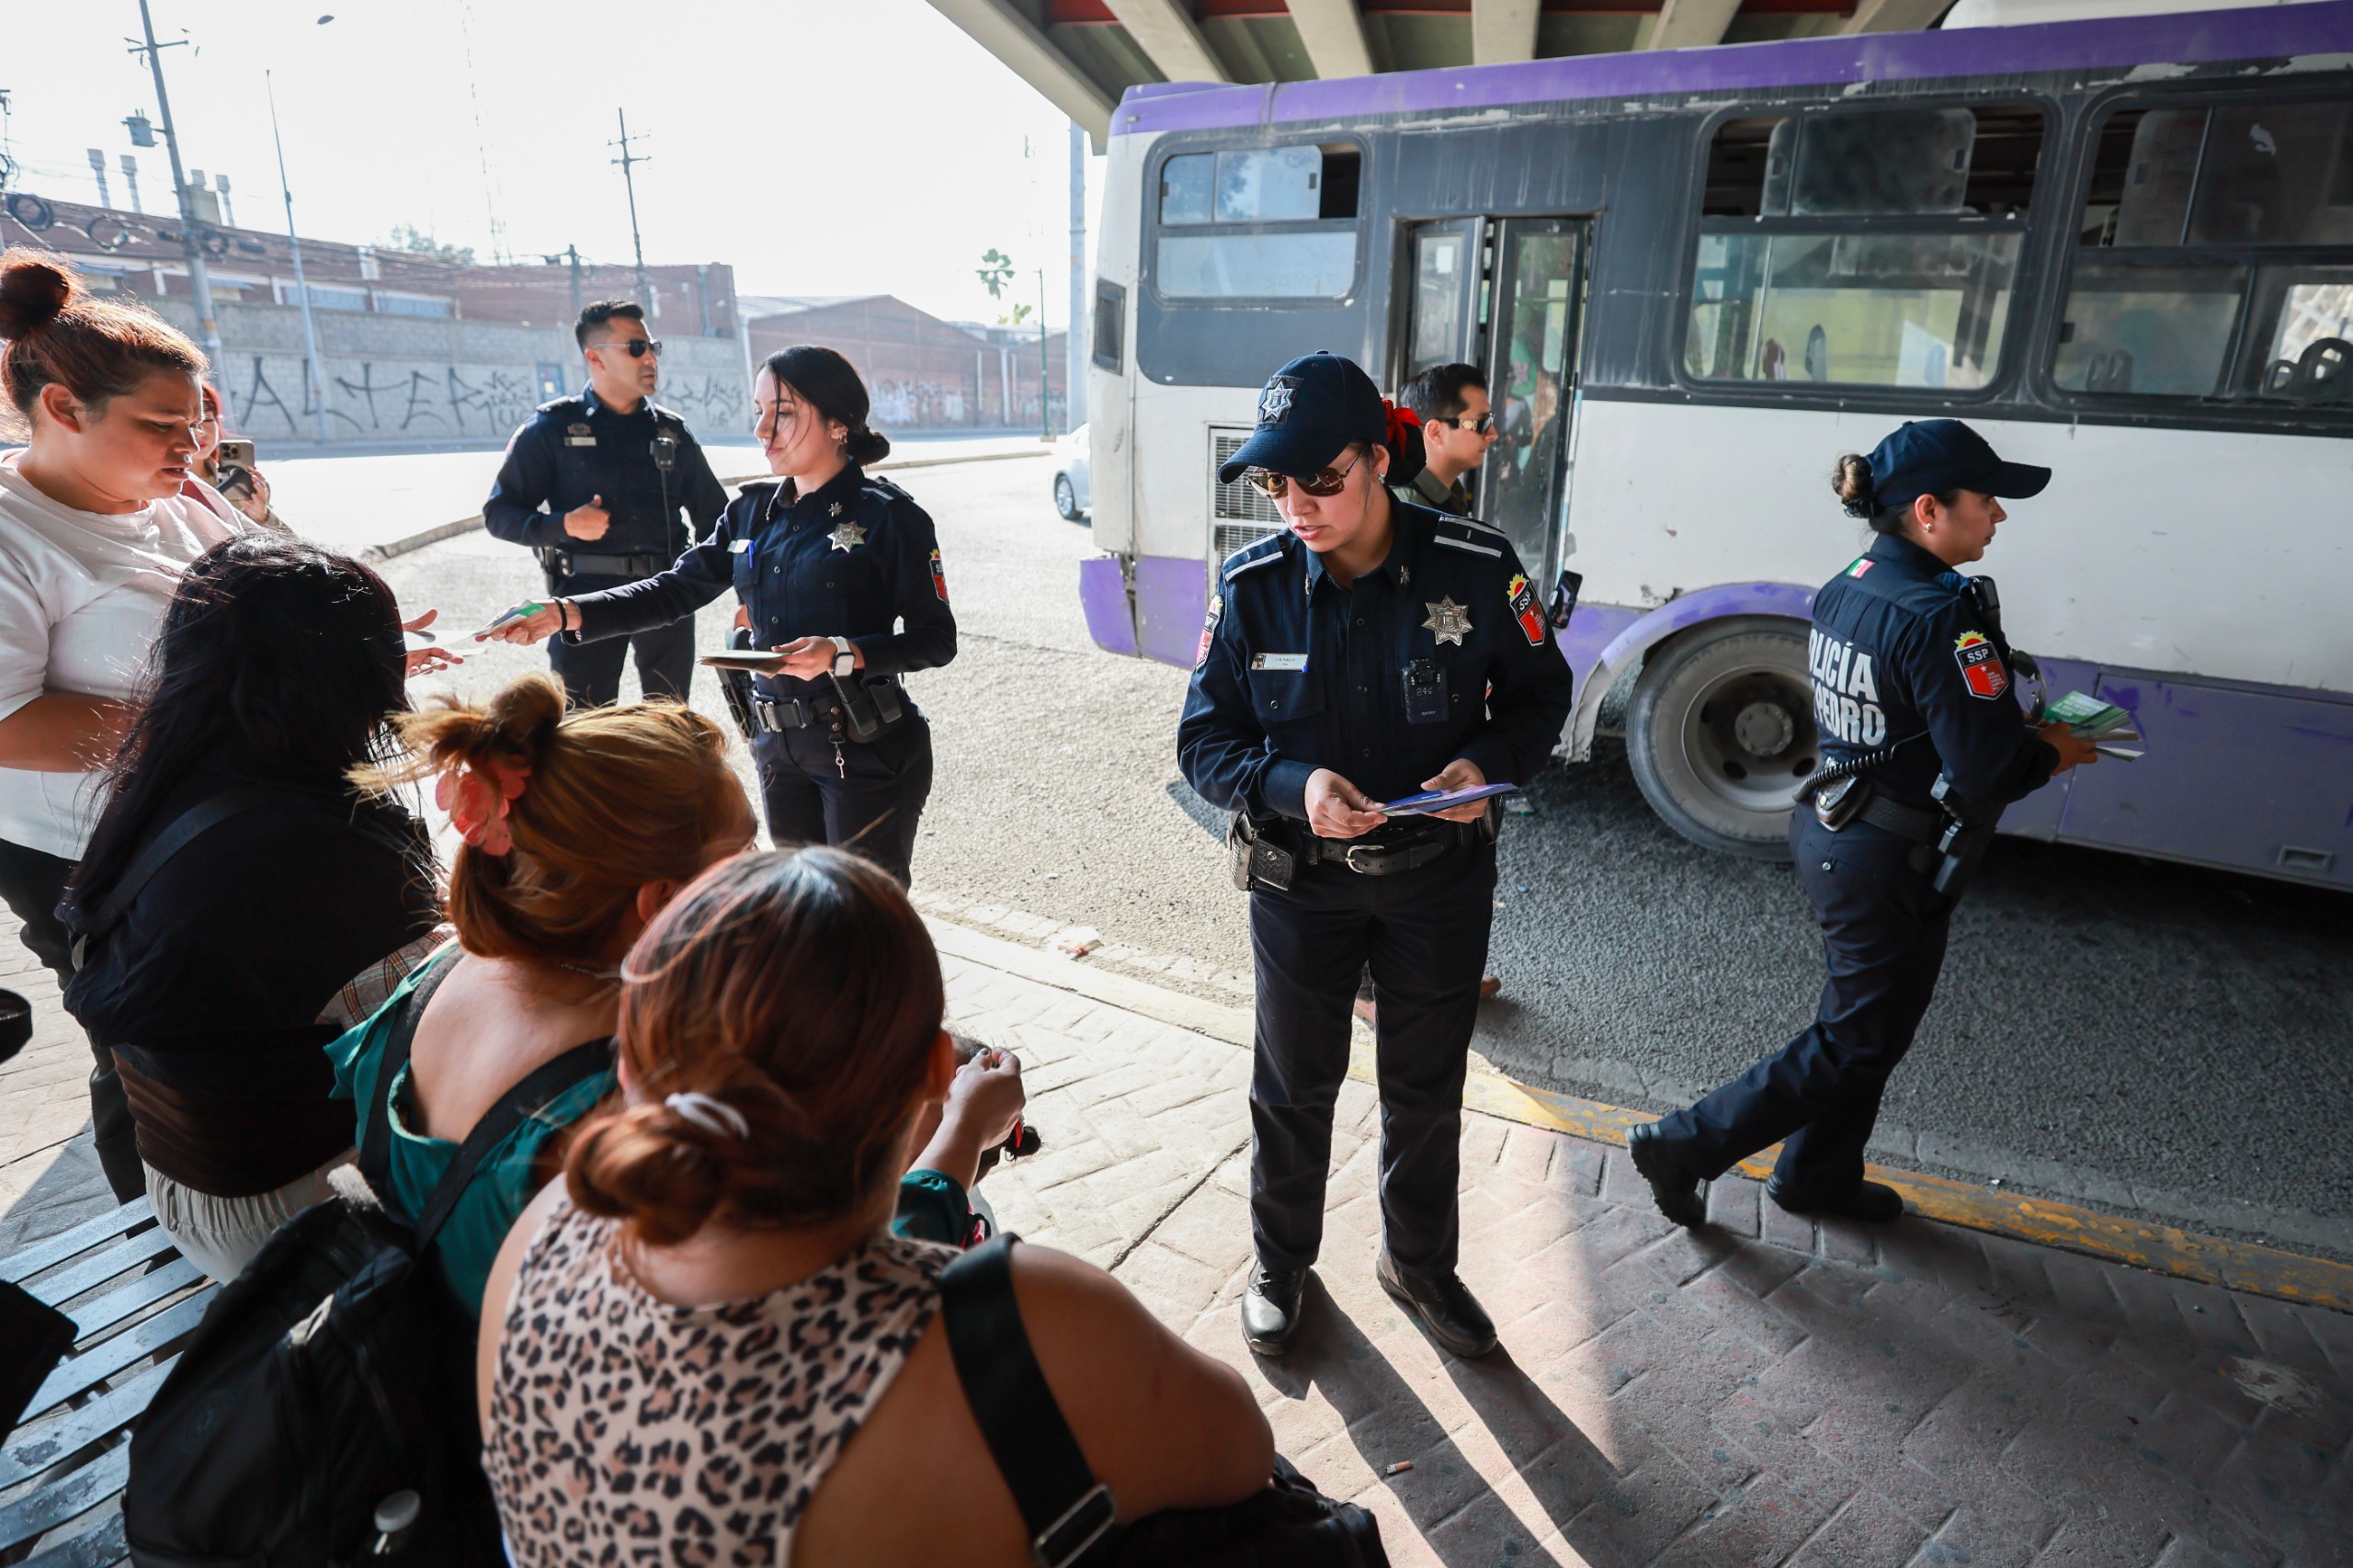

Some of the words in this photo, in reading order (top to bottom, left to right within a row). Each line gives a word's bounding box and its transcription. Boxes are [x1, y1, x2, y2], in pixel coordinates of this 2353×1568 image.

[1519, 591, 1531, 611] SSP
[1808, 628, 1880, 702] OLICÍA
[1967, 648, 1989, 663] SSP
